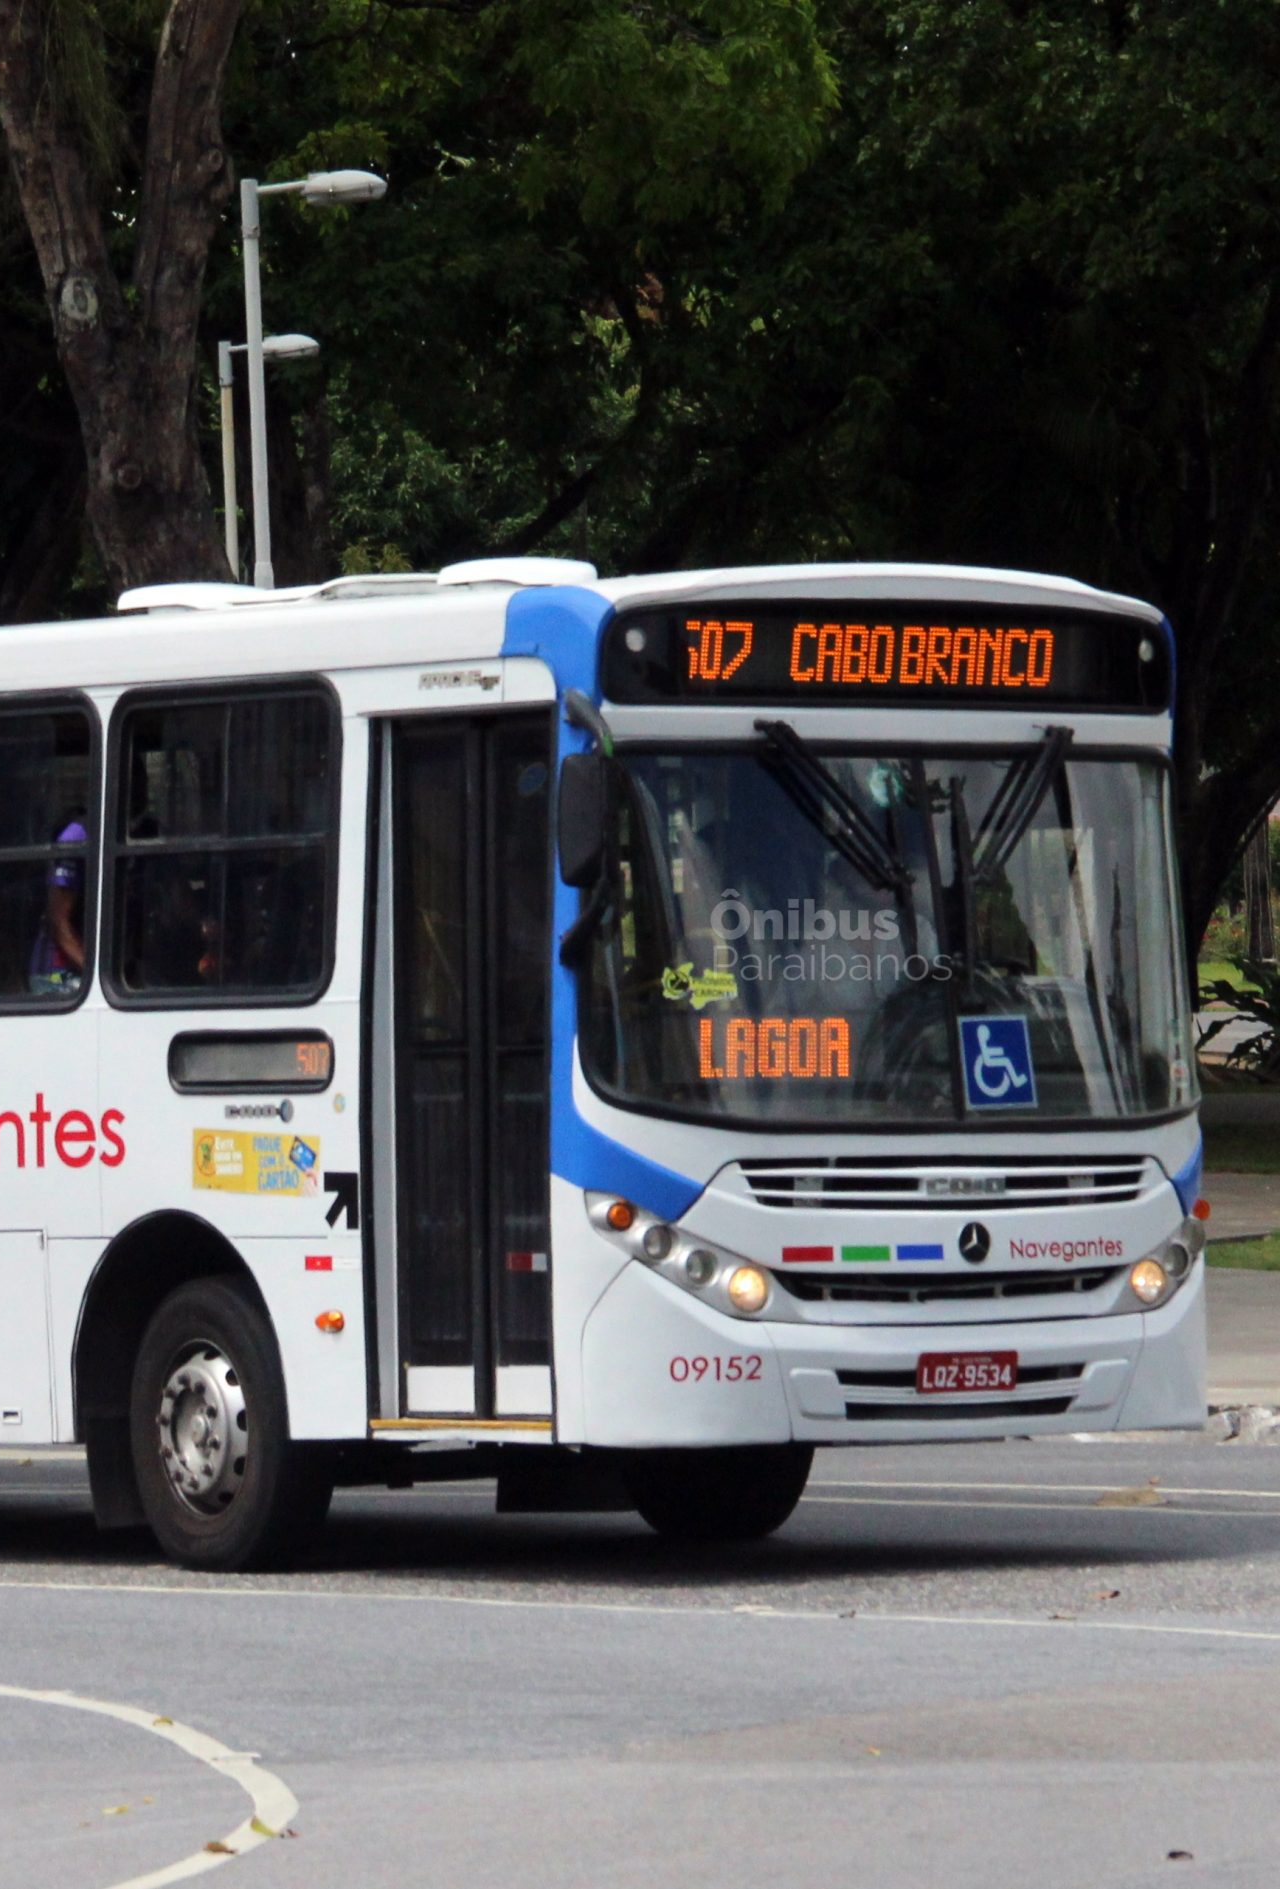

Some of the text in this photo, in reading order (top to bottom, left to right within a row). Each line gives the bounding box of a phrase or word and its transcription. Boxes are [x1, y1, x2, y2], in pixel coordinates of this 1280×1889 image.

[790, 623, 895, 683] CABO
[899, 626, 1055, 687] BRANCO
[699, 1017, 851, 1079] LAGOA
[1009, 1237, 1123, 1262] Navegantes
[670, 1355, 763, 1382] 09152
